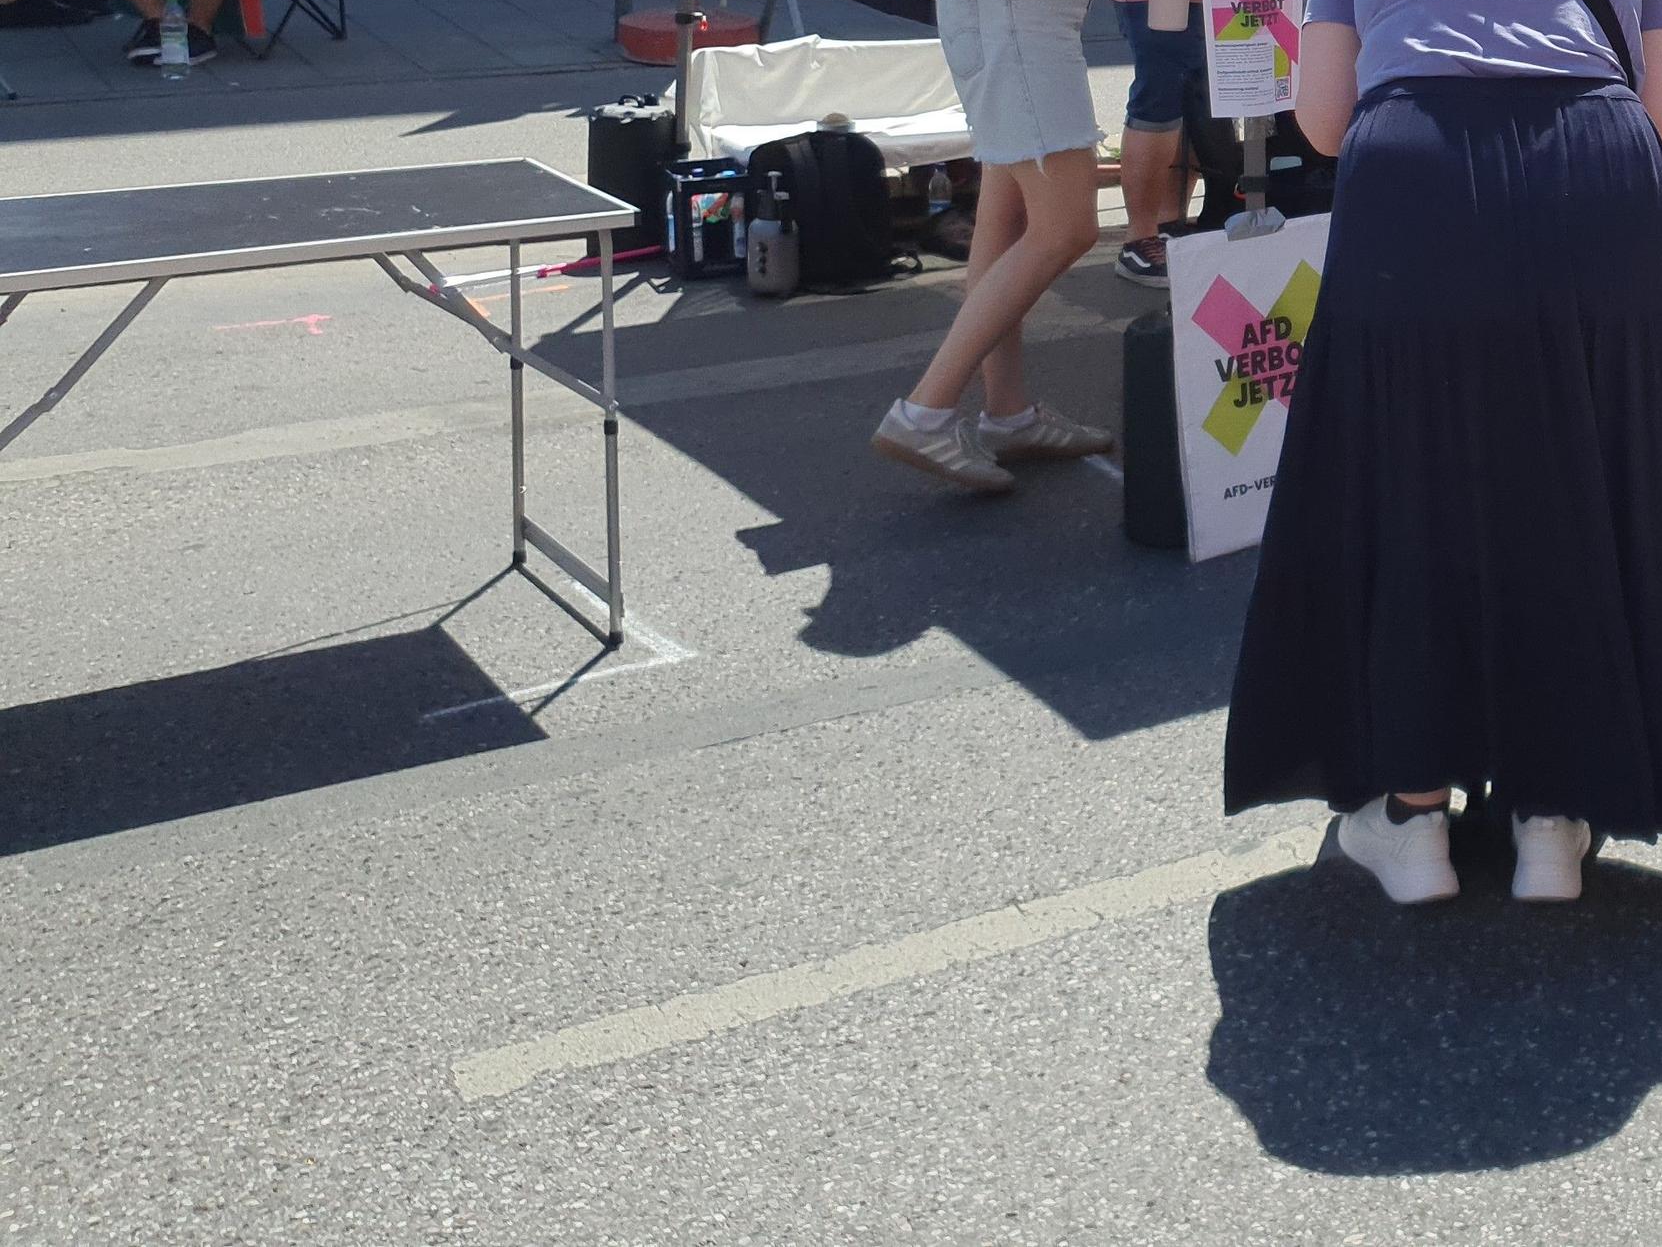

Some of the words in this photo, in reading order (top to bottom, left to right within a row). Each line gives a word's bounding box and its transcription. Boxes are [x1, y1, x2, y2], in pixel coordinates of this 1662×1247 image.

[1240, 14, 1279, 28] JETZT
[1241, 315, 1293, 350] AFD
[1214, 340, 1303, 384] VERBO
